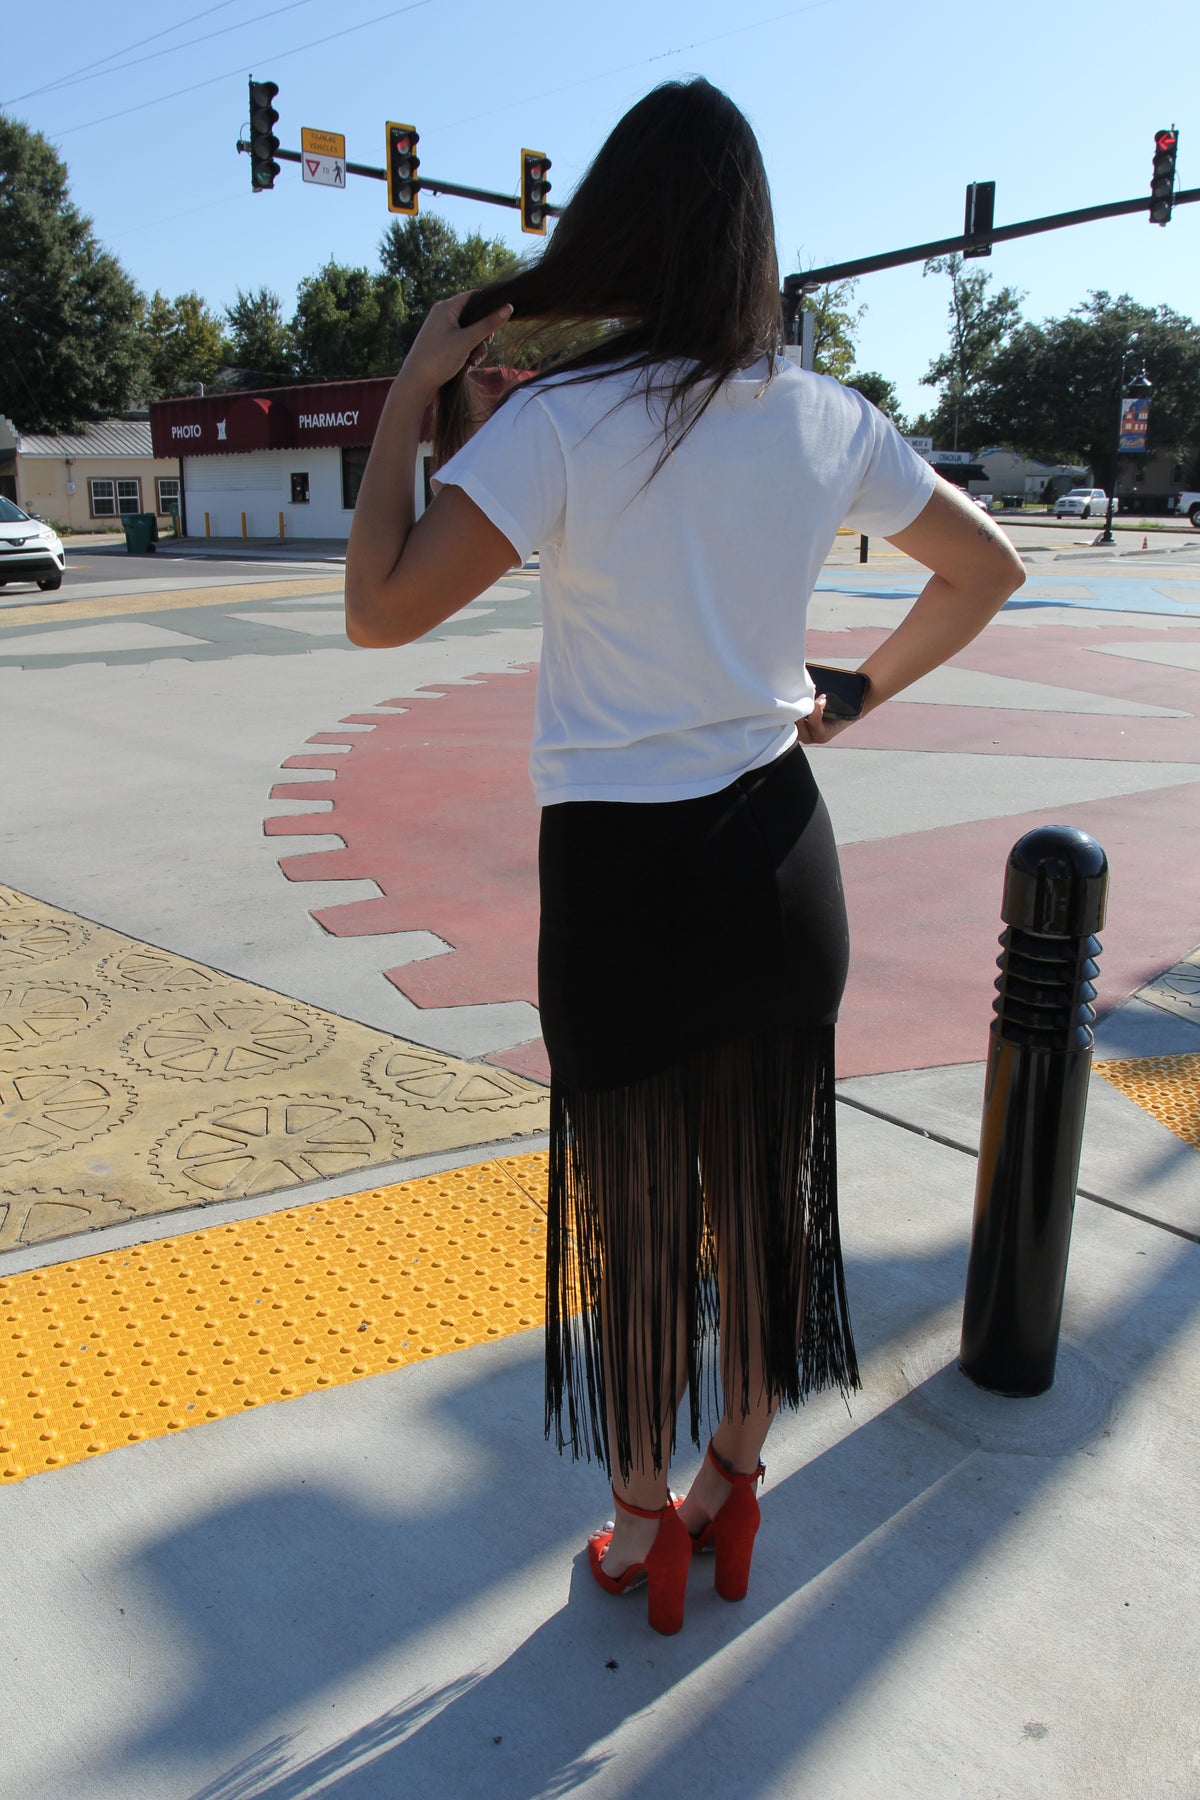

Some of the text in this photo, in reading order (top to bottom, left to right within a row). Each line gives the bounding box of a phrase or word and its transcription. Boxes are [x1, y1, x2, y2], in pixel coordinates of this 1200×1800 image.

[311, 132, 337, 143] TURNING
[310, 142, 338, 153] VEHICLES
[299, 411, 360, 429] PHARMACY
[171, 424, 202, 439] PHOTO
